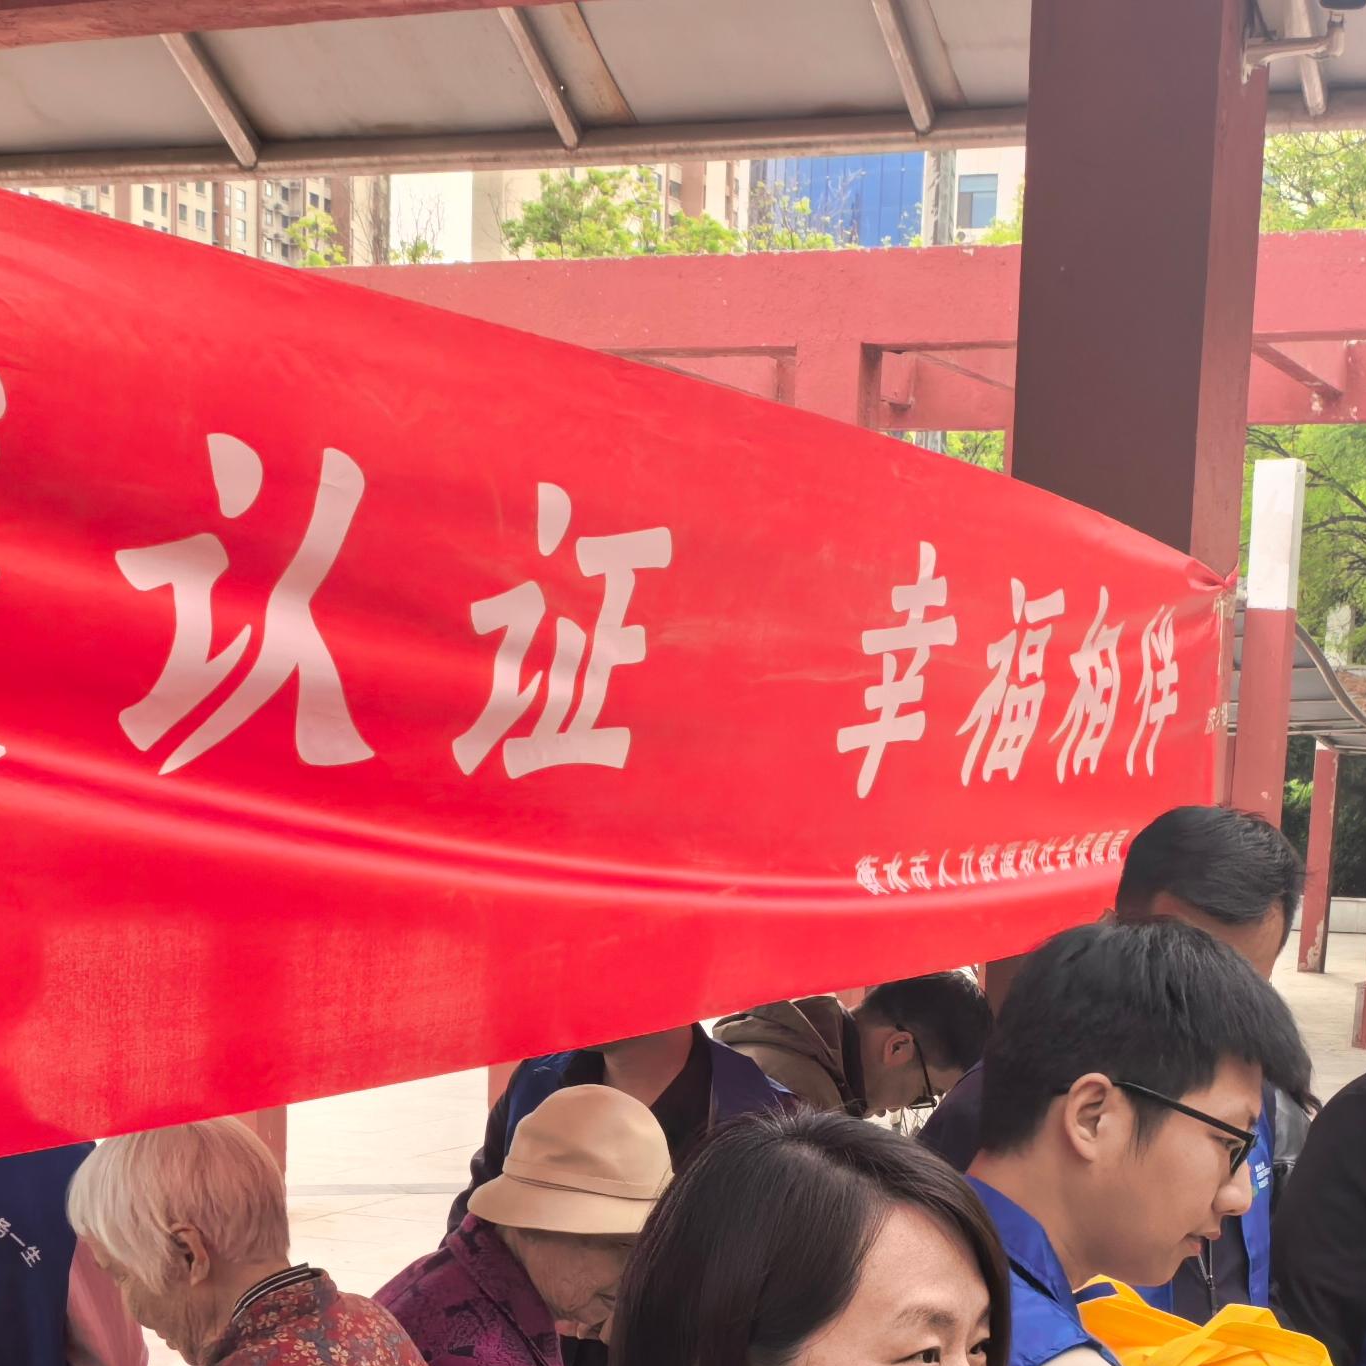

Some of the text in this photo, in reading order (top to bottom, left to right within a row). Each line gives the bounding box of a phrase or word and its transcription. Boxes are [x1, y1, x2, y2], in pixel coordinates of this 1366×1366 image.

[836, 540, 1178, 799] 幸福相伴
[855, 829, 1130, 896] 衡水市人力资源和社会保障局
